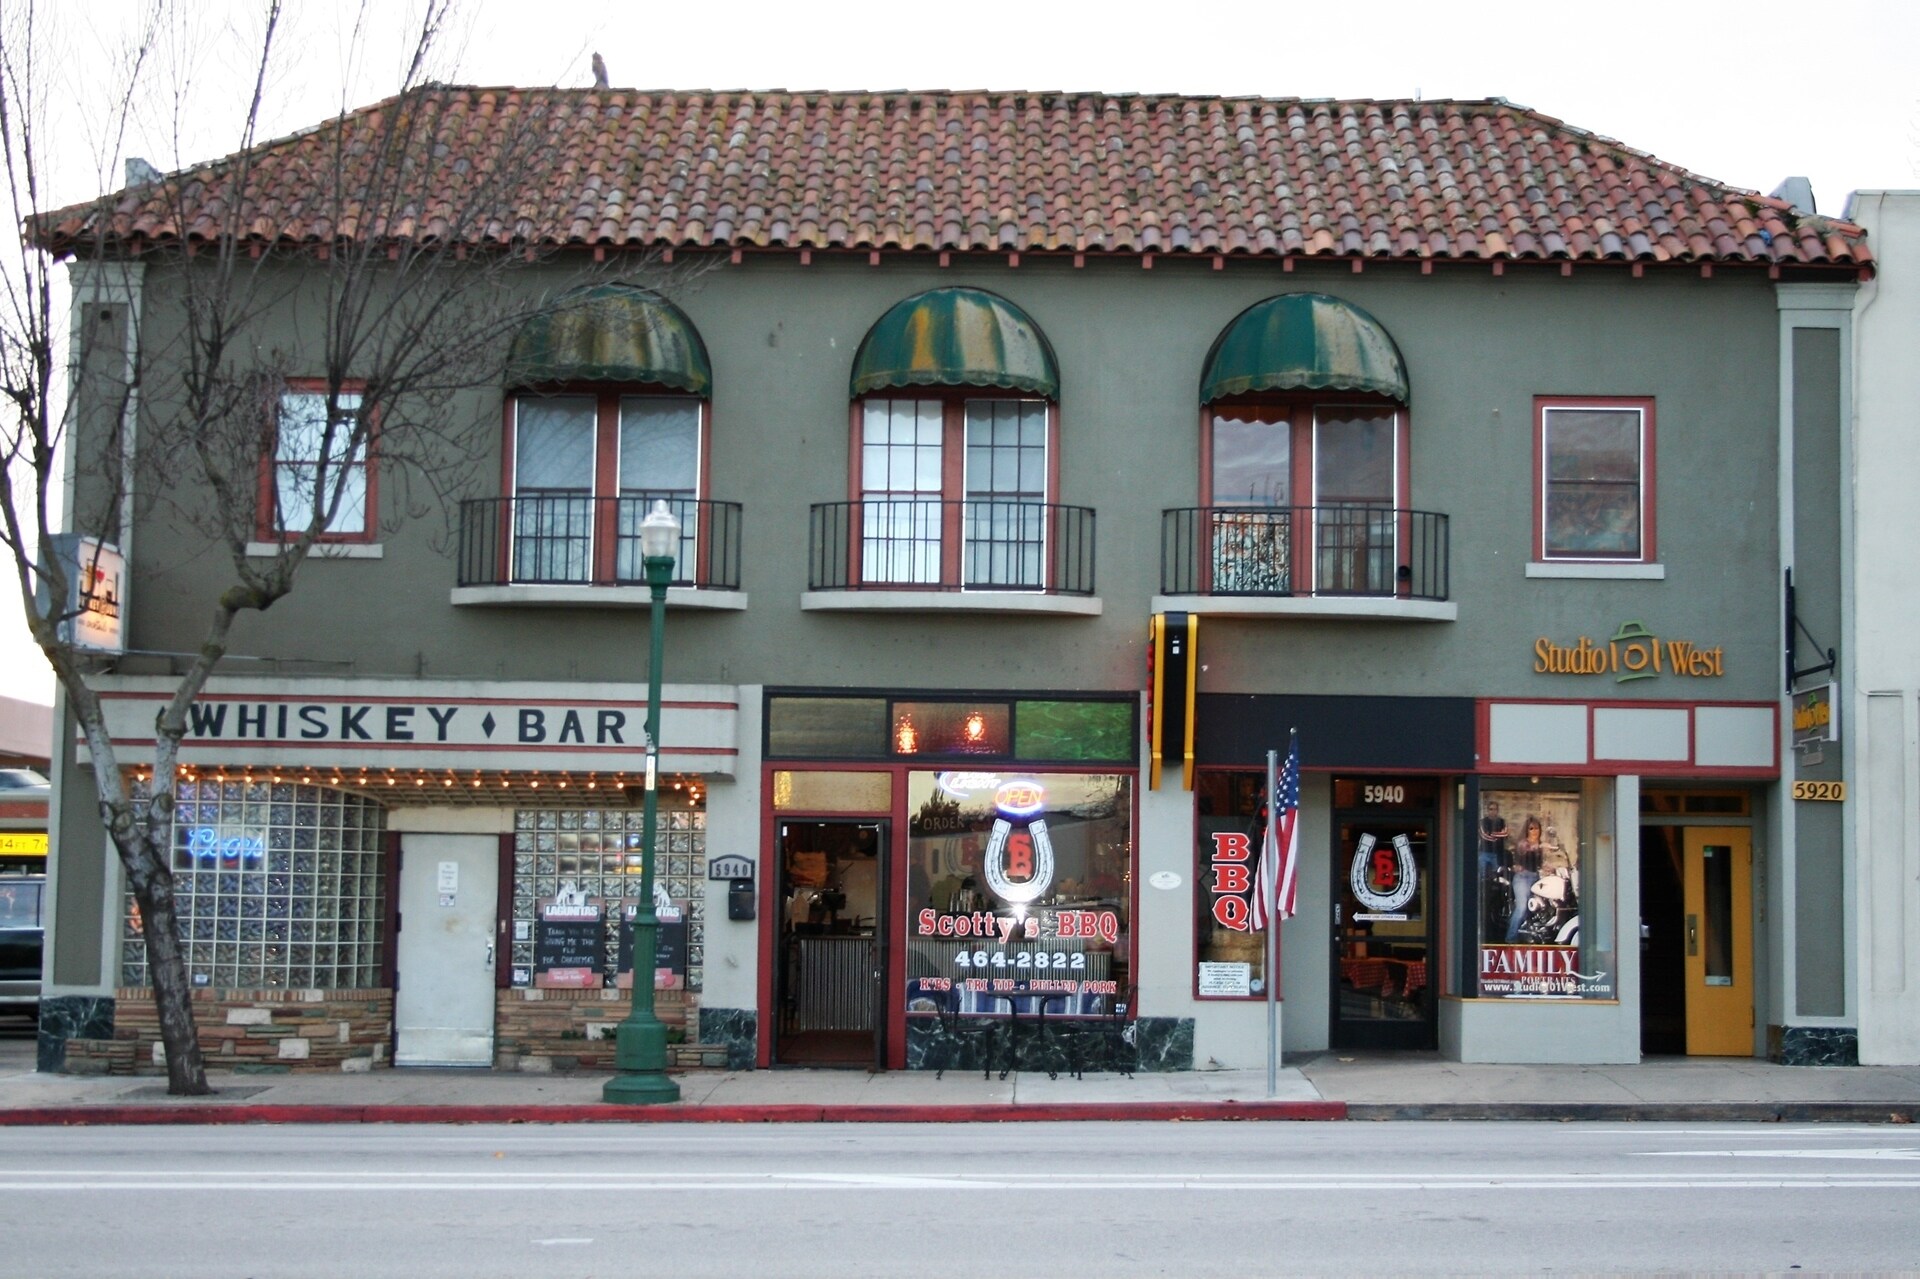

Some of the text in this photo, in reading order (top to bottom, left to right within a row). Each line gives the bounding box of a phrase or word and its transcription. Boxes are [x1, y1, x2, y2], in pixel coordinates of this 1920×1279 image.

[1534, 636, 1606, 674] Studio
[1667, 640, 1724, 677] West
[190, 703, 626, 744] WHISKEY BAR
[995, 788, 1043, 806] OPEN
[1364, 785, 1404, 803] 5940
[1794, 782, 1842, 800] 5920
[923, 815, 966, 831] ORDER
[188, 828, 264, 858] Coors
[715, 863, 749, 877] 5940
[1212, 832, 1250, 931] BBQ
[545, 904, 598, 917] LAGUNITAS
[918, 908, 1118, 943] Scotty's BBQ
[954, 950, 1086, 969] 464-2822
[1481, 949, 1577, 974] FAMILY
[966, 978, 988, 991] TRI
[1084, 981, 1117, 994] PORK
[1521, 975, 1576, 986] PORTRAITS
